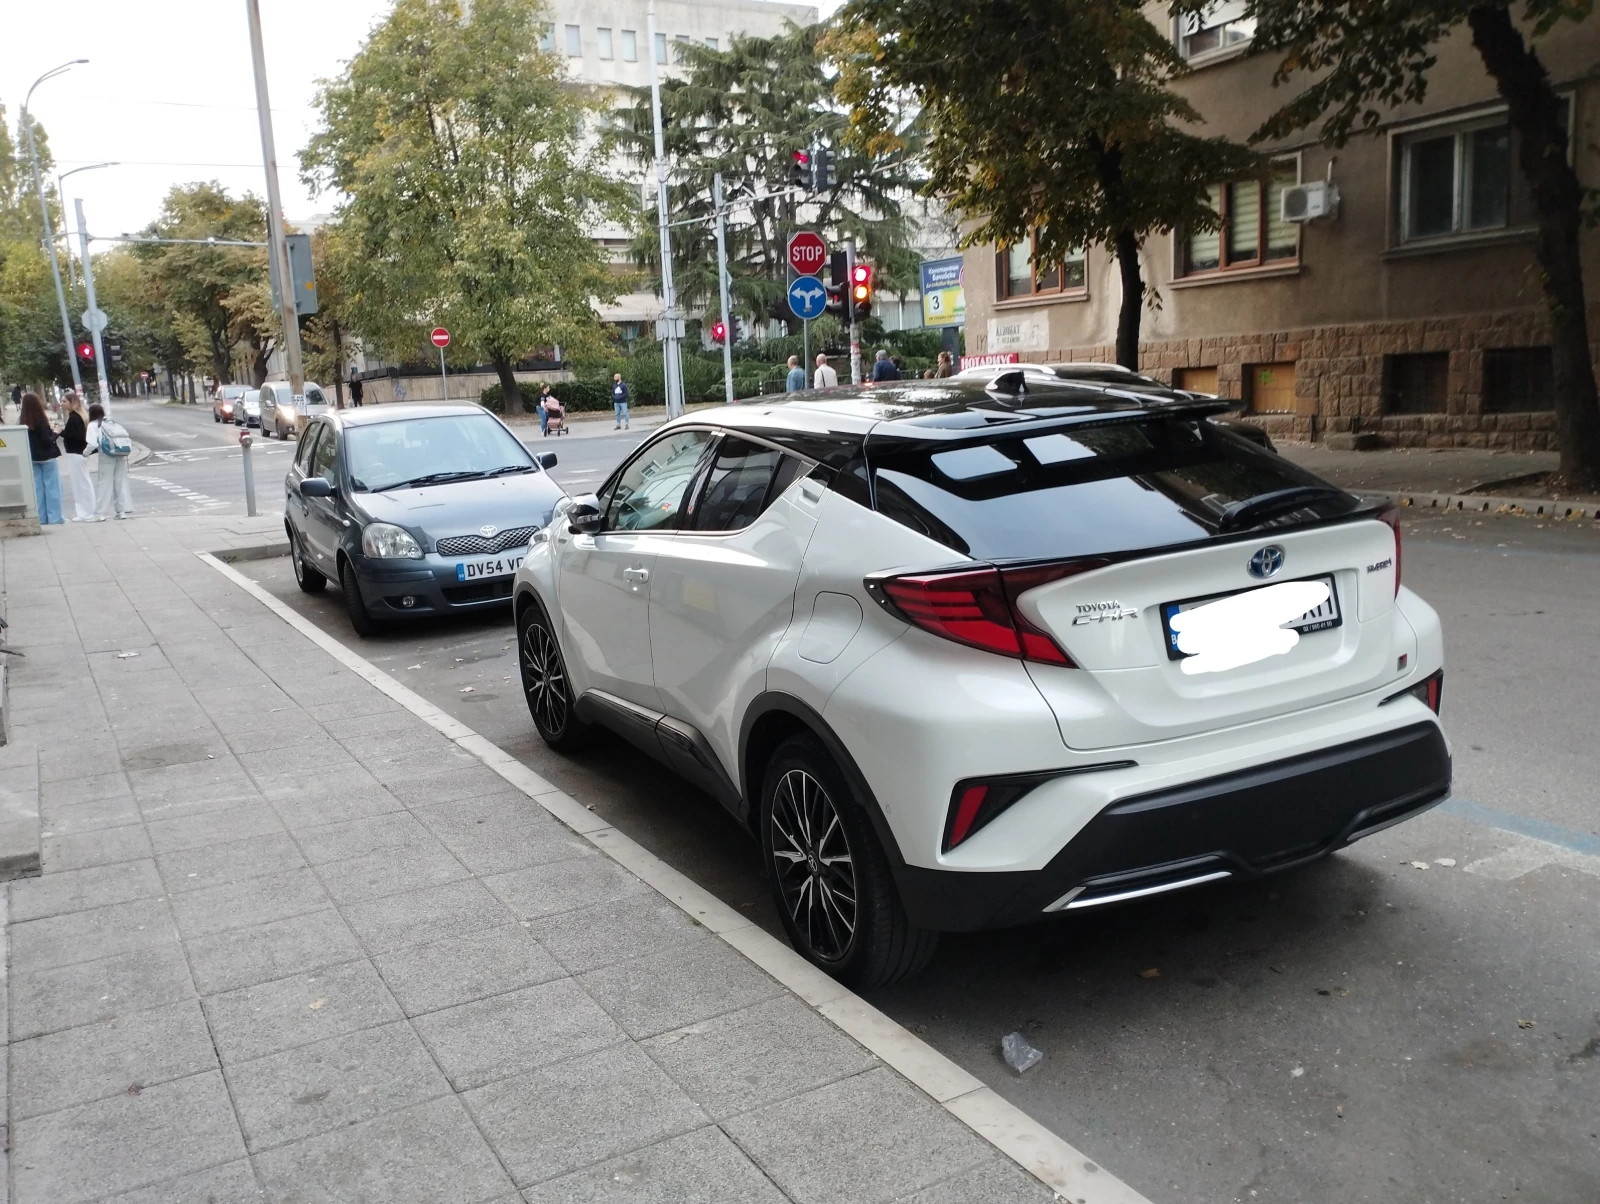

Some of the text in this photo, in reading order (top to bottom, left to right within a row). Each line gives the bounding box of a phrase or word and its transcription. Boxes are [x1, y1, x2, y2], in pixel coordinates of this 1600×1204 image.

[792, 246, 823, 262] STOP
[932, 295, 940, 310] 3
[466, 560, 504, 578] DV54
[1076, 600, 1121, 613] TOYOTA
[1071, 607, 1138, 626] C-HR
